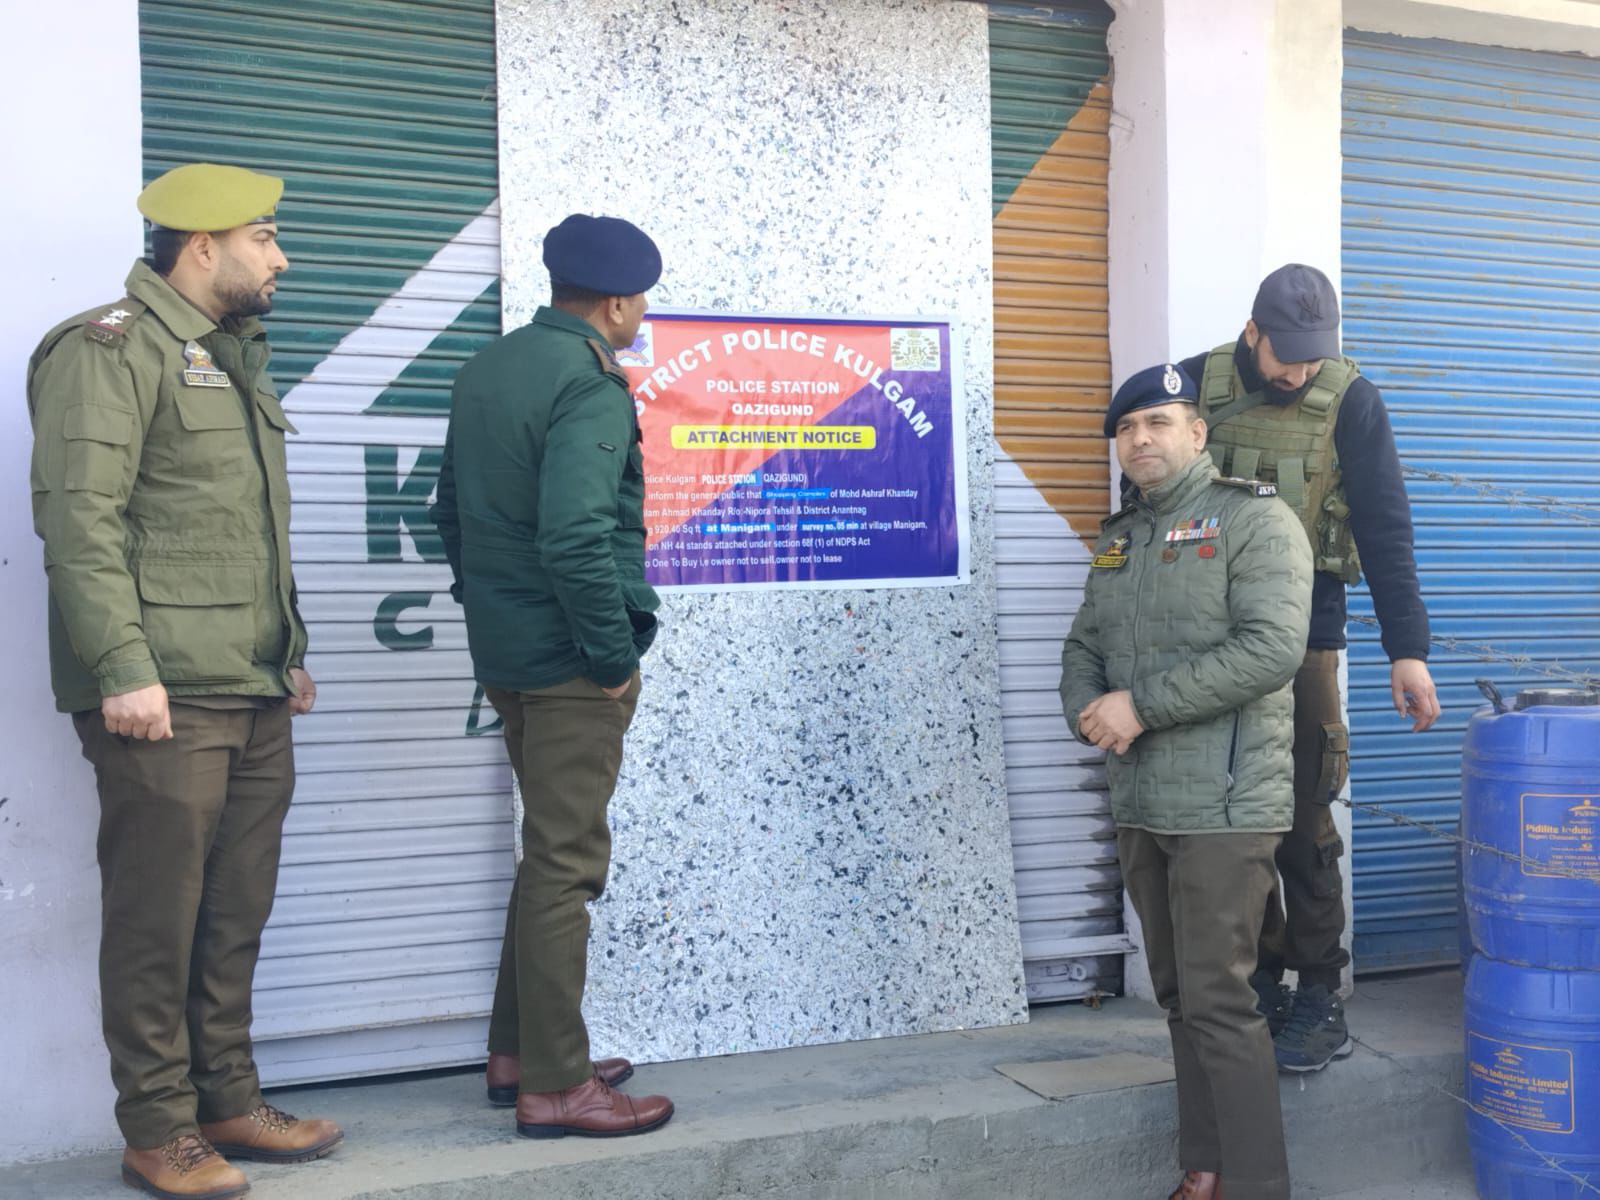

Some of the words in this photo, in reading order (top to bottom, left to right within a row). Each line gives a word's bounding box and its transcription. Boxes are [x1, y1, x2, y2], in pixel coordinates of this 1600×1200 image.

[706, 380, 766, 393] POLICE
[771, 381, 839, 394] STATION
[722, 328, 827, 357] POLICE
[833, 343, 934, 439] KULGAM
[732, 403, 814, 416] QAZIGUND
[688, 431, 798, 444] ATTACHMENT
[803, 431, 862, 443] NOTICE
[645, 474, 663, 484] olice
[701, 473, 727, 485] POLICE
[728, 473, 756, 484] STATION
[675, 490, 689, 500] the
[690, 491, 721, 503] general
[721, 490, 745, 501] public
[746, 489, 762, 499] that
[830, 489, 838, 498] of
[839, 488, 860, 498] Mohd
[861, 488, 885, 498] Ashraf
[886, 488, 918, 499] Khanday
[661, 506, 690, 517] Ahmad
[691, 506, 726, 518] Khanday
[773, 505, 795, 515] Tehsil
[803, 505, 830, 515] District
[831, 505, 867, 516] Anantnag
[682, 523, 694, 535] Sq
[705, 523, 718, 533] at
[720, 522, 771, 534] Manigam
[776, 521, 798, 532] under
[860, 521, 868, 531] at
[868, 520, 892, 532] village
[661, 540, 674, 550] NH
[674, 540, 685, 550] 44
[686, 540, 713, 550] stands
[714, 539, 748, 550] attached
[749, 539, 772, 549] under
[773, 538, 800, 549] section
[825, 537, 834, 547] of
[835, 536, 857, 547] NDPS
[858, 536, 871, 546] Act
[652, 558, 670, 568] One
[671, 557, 681, 567] To
[682, 557, 698, 569] Buy
[710, 557, 736, 567] owner
[737, 556, 749, 566] not
[750, 555, 759, 565] to
[800, 554, 813, 564] not
[813, 554, 822, 564] to
